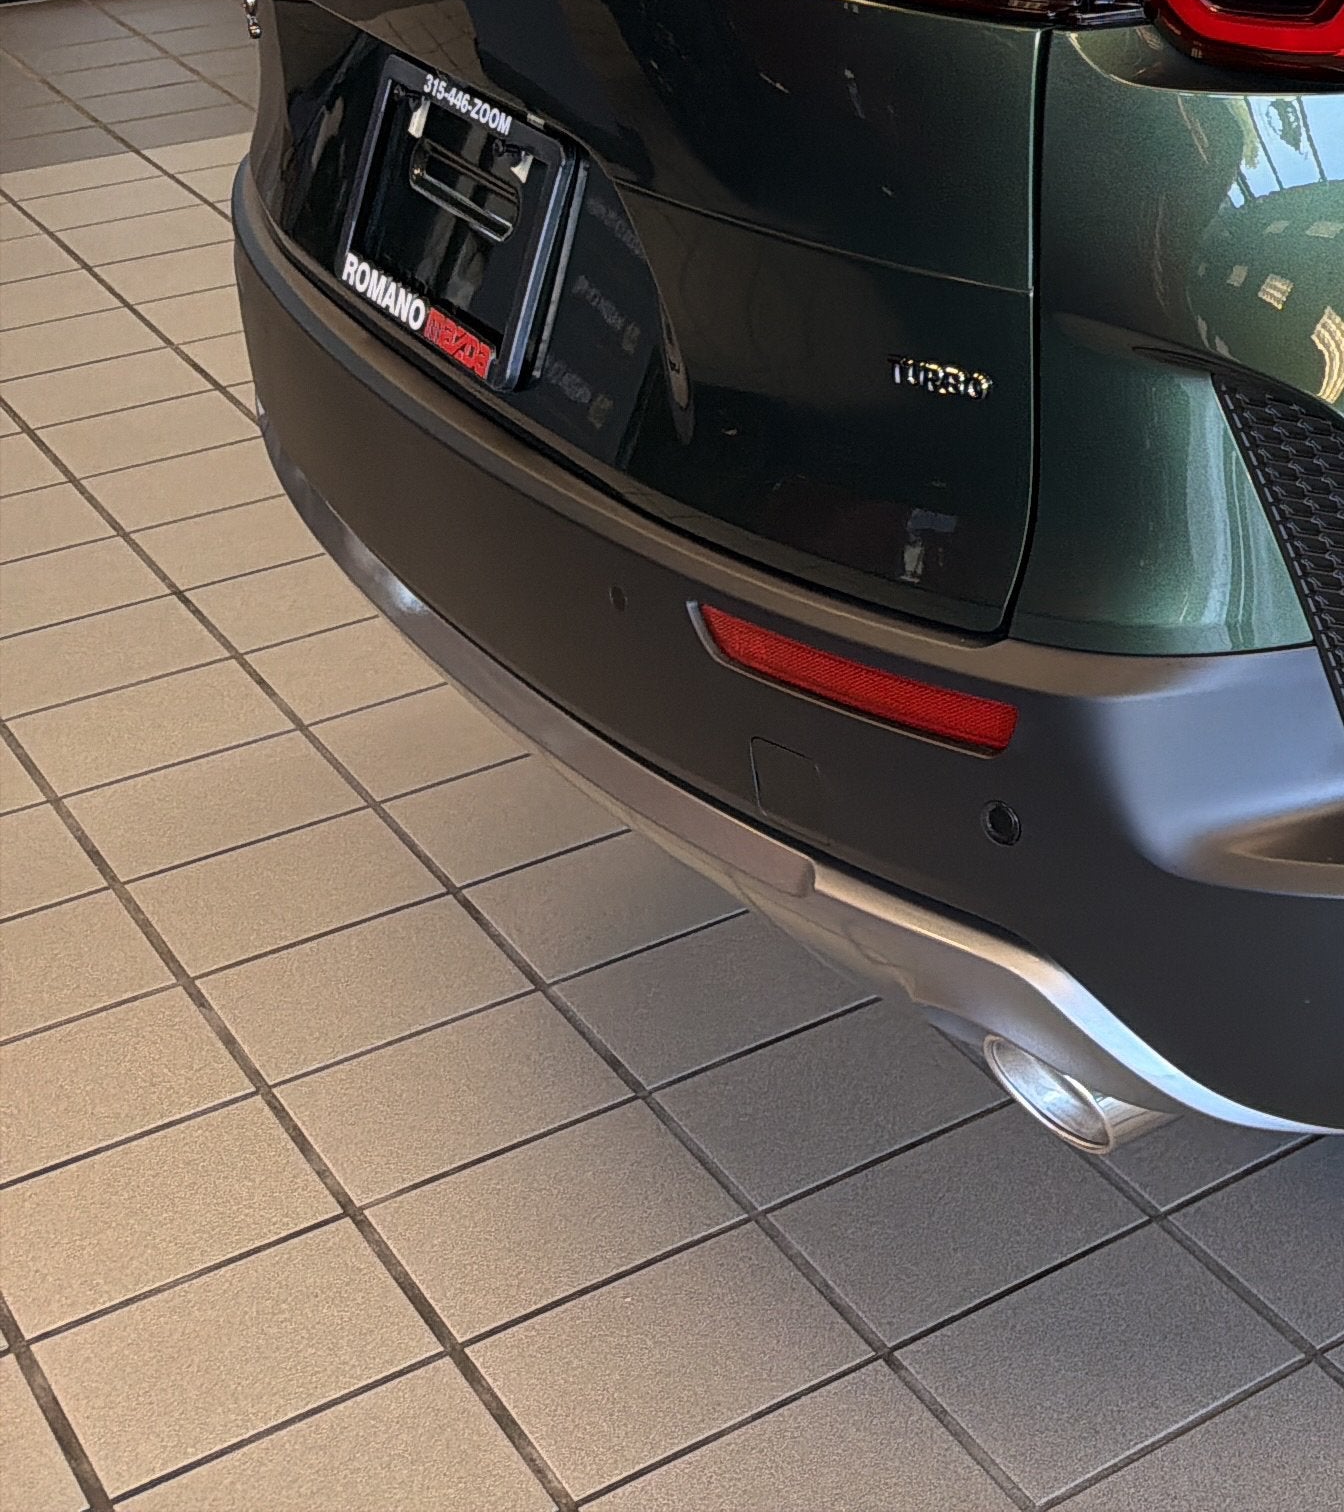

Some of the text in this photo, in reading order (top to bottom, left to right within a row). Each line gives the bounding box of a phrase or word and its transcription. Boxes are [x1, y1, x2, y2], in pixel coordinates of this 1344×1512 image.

[423, 73, 512, 135] 315-446-ZOOM
[341, 252, 426, 332] ROMANO
[887, 353, 993, 400] TURBO
